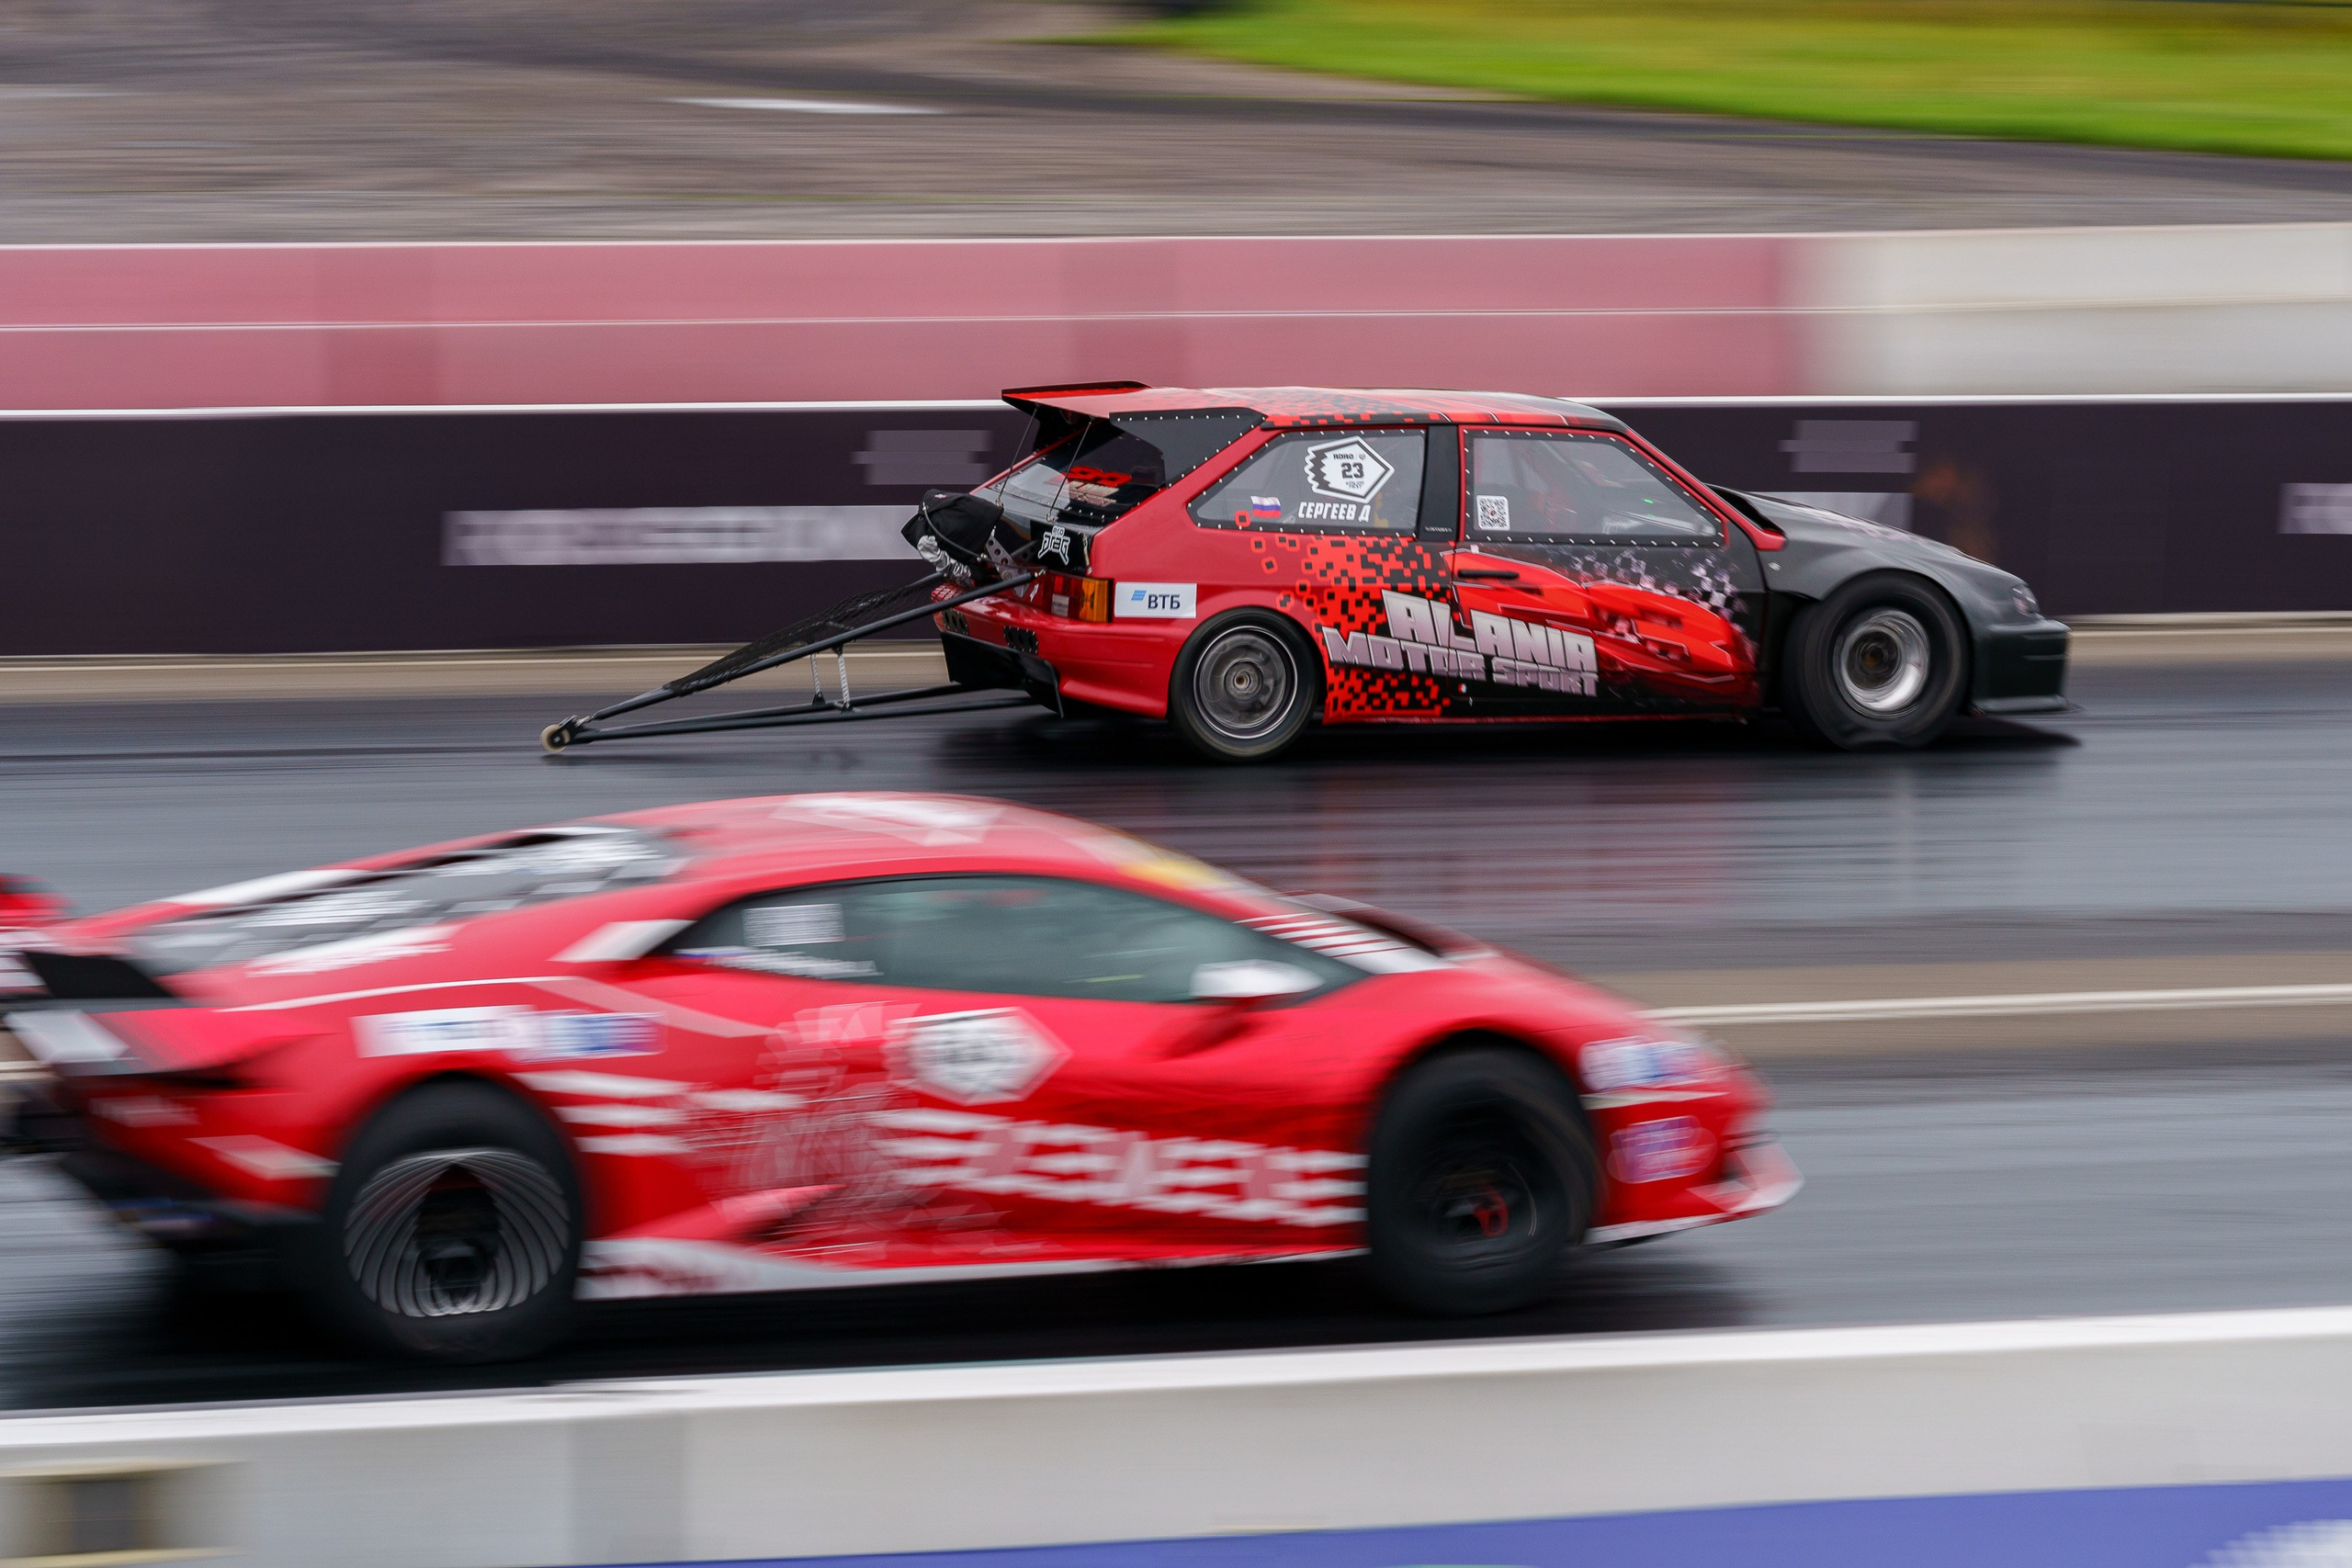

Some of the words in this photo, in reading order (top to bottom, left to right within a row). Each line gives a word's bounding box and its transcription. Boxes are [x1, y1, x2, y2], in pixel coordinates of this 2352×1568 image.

[1340, 462, 1364, 479] 23
[1297, 501, 1357, 521] СЕРГЕЕВ
[1358, 504, 1372, 523] Д
[1147, 593, 1182, 610] ВТБ
[1381, 588, 1599, 672] ALANIA
[1321, 626, 1487, 682] MOTOR
[1491, 656, 1600, 697] SPORT
